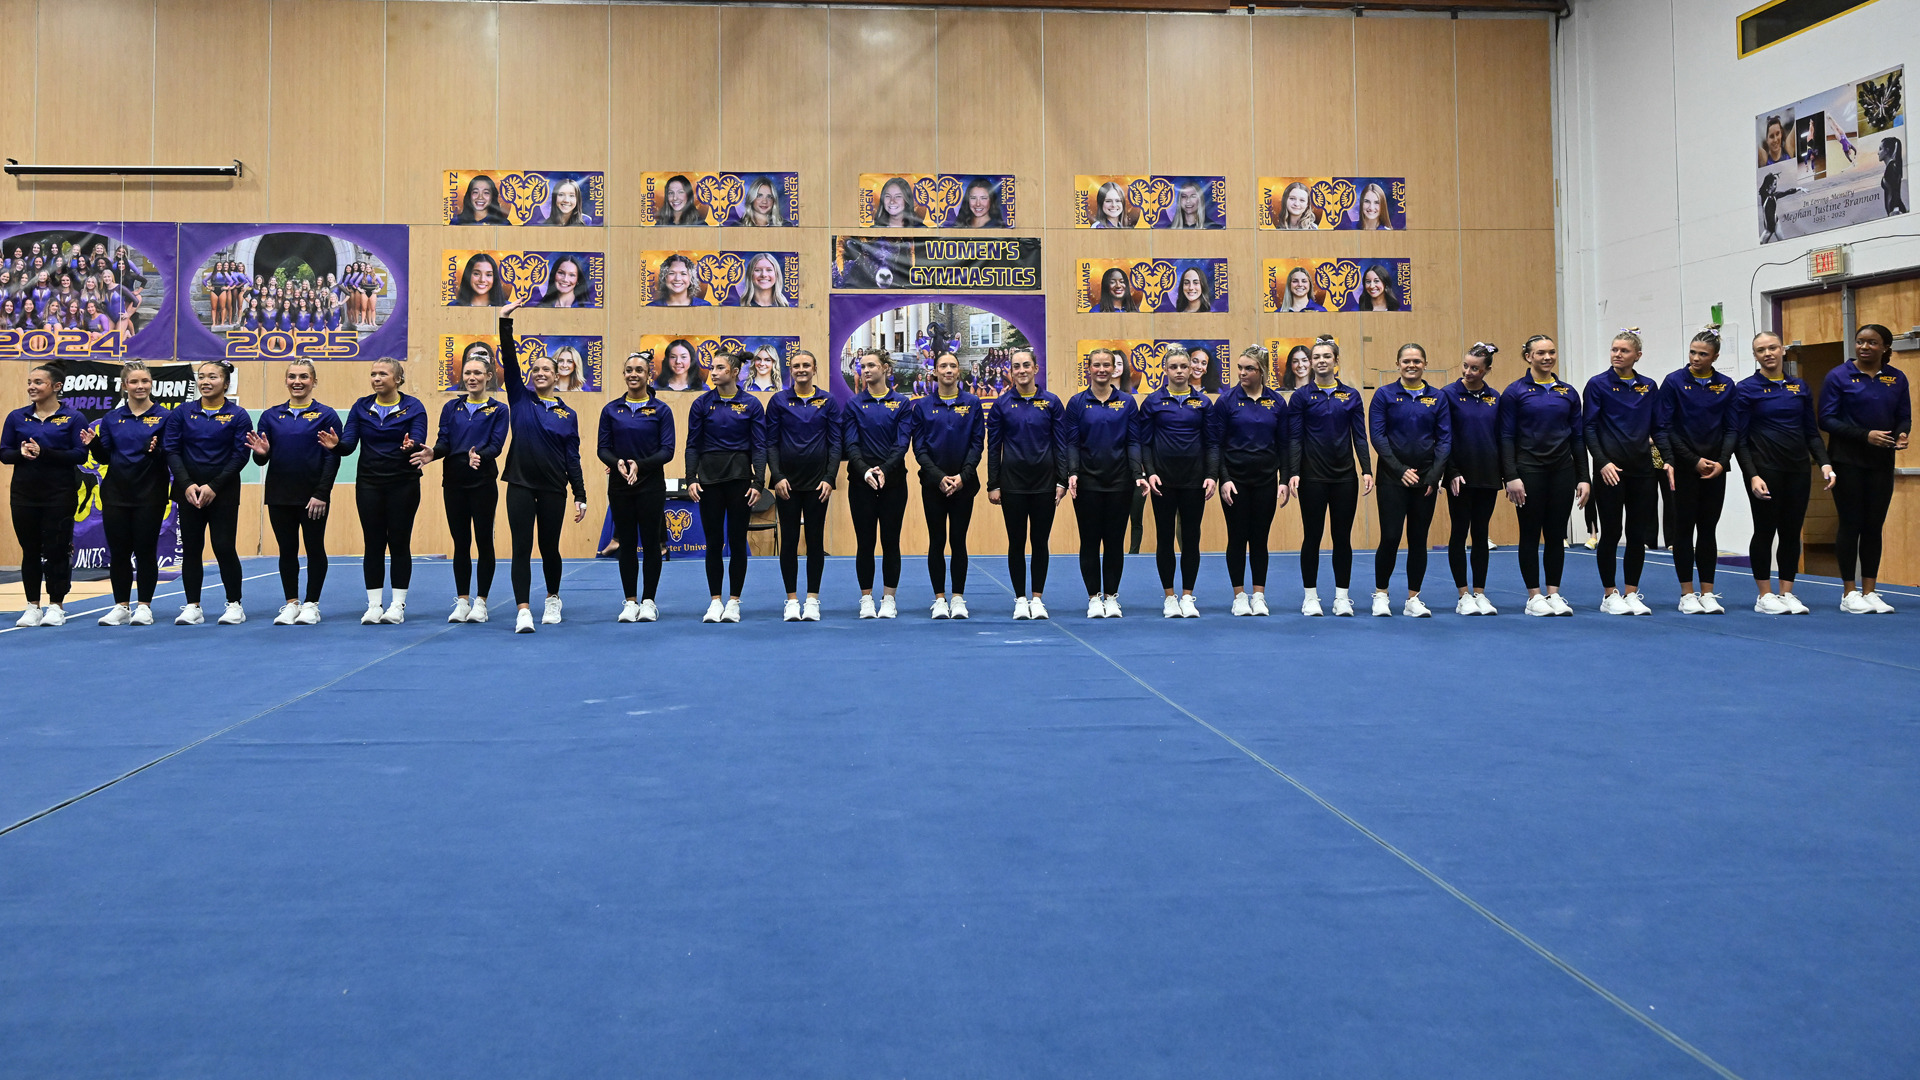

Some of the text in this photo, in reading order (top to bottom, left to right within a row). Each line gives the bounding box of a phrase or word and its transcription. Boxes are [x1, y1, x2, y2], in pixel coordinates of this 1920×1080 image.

[449, 172, 458, 220] SCHULTZ
[595, 175, 603, 216] RINGAS
[646, 177, 655, 222] GRUBER
[790, 176, 798, 221] STONER
[865, 190, 873, 223] LYDEN
[1007, 178, 1015, 227] SHELTON
[1217, 180, 1225, 218] VARGO
[1264, 187, 1272, 226] ESKEW
[1397, 182, 1405, 214] LACEY
[1782, 192, 1880, 223] Meghan Justine Brannon
[1810, 196, 1829, 207] Loving
[1831, 190, 1854, 201] Memory
[1831, 210, 1846, 219] 2023
[925, 240, 1020, 260] WOMEN'S
[1815, 251, 1834, 273] EXIT
[448, 255, 457, 301] HARADA
[595, 257, 603, 307] McGUINN
[647, 270, 655, 302] KELLY
[790, 256, 798, 299] KEENER
[909, 266, 1036, 286] GYMNASTICS
[1082, 262, 1090, 309] WILLIAMS
[1220, 263, 1228, 295] TATUM
[1403, 262, 1411, 306] SALVATORI
[0, 329, 127, 357] 2024
[225, 330, 360, 358] 2025
[445, 336, 454, 387] McCULLOUGH
[593, 340, 602, 387] McNAMARA
[63, 374, 108, 392] BORN
[114, 377, 122, 393] T
[151, 380, 187, 397] URN
